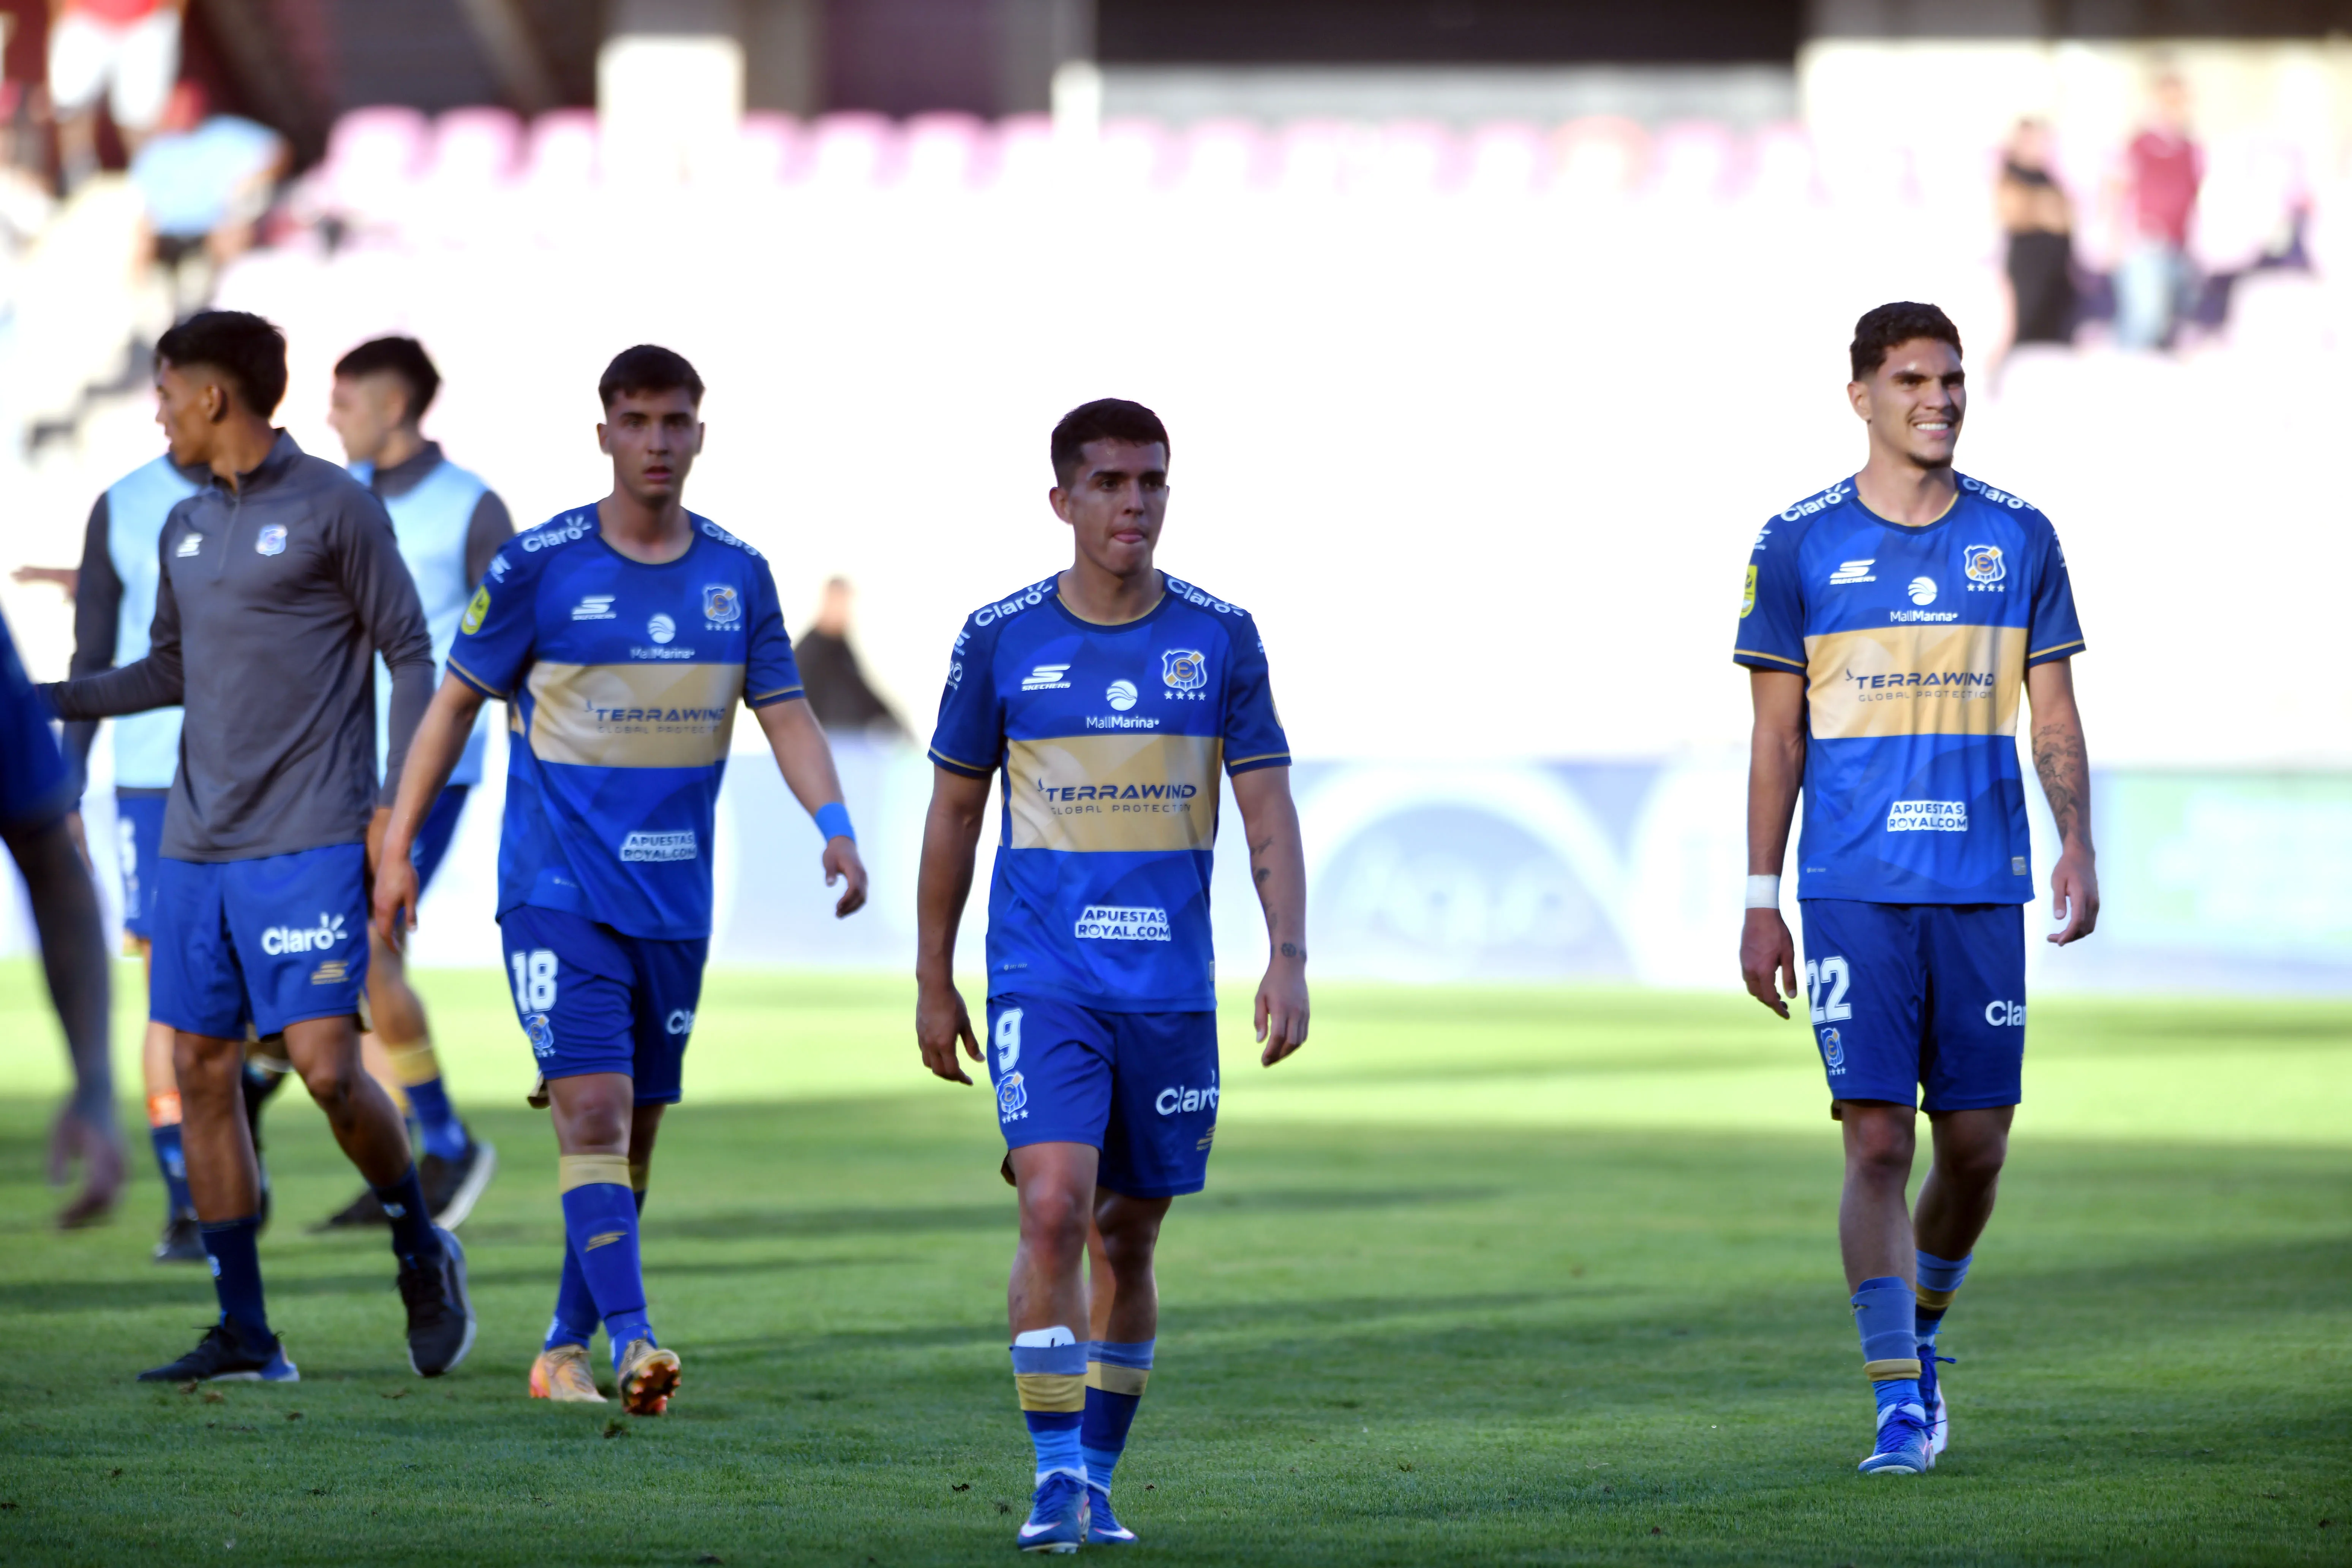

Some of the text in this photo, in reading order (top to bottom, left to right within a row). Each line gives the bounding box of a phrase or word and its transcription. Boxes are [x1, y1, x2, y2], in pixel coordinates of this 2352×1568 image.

[1962, 477, 2024, 509] Claro
[1780, 492, 1842, 522] Claro
[522, 526, 584, 553] Claro
[702, 523, 759, 556] Claro
[1167, 579, 1231, 614] Claro
[975, 592, 1042, 627] Claro
[1890, 610, 1953, 622] MallMarina
[1021, 683, 1072, 692] SKECHERS
[1855, 672, 1995, 689] TERRAWIND
[1858, 691, 1911, 702] GLOBAL
[1086, 715, 1154, 729] MallMarina
[1045, 784, 1197, 802] TERRAWIND
[1893, 804, 1963, 815] APUESTAS
[629, 835, 693, 847] APUESTAS
[1083, 910, 1166, 923] APUESTAS
[262, 926, 335, 956] Claro
[1078, 924, 1170, 939] ROYAL.COM
[512, 951, 559, 1014] 18
[1805, 956, 1852, 1026] 22
[995, 1008, 1024, 1075] 9
